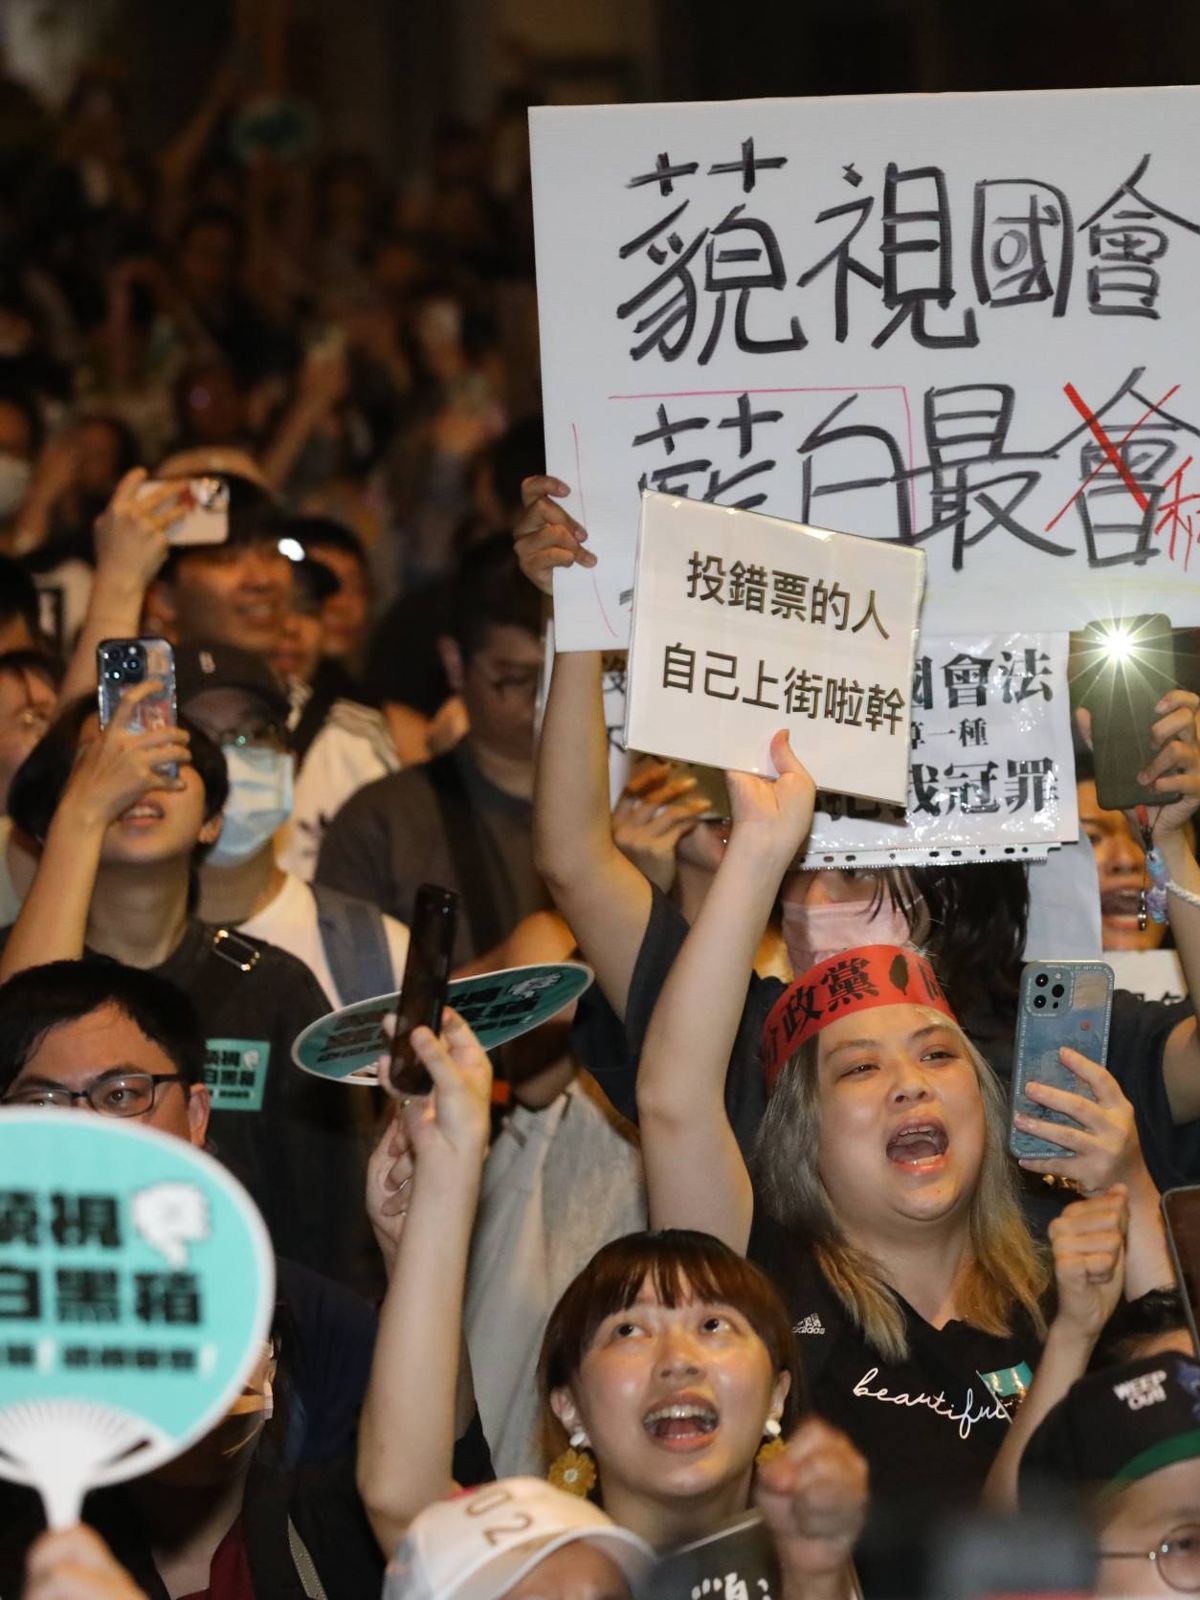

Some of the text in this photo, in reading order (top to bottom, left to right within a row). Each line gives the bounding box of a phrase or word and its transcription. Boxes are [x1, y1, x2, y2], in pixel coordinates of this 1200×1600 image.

[686, 551, 891, 641] 投錯票的人
[662, 642, 906, 736] 自己上街啦幹
